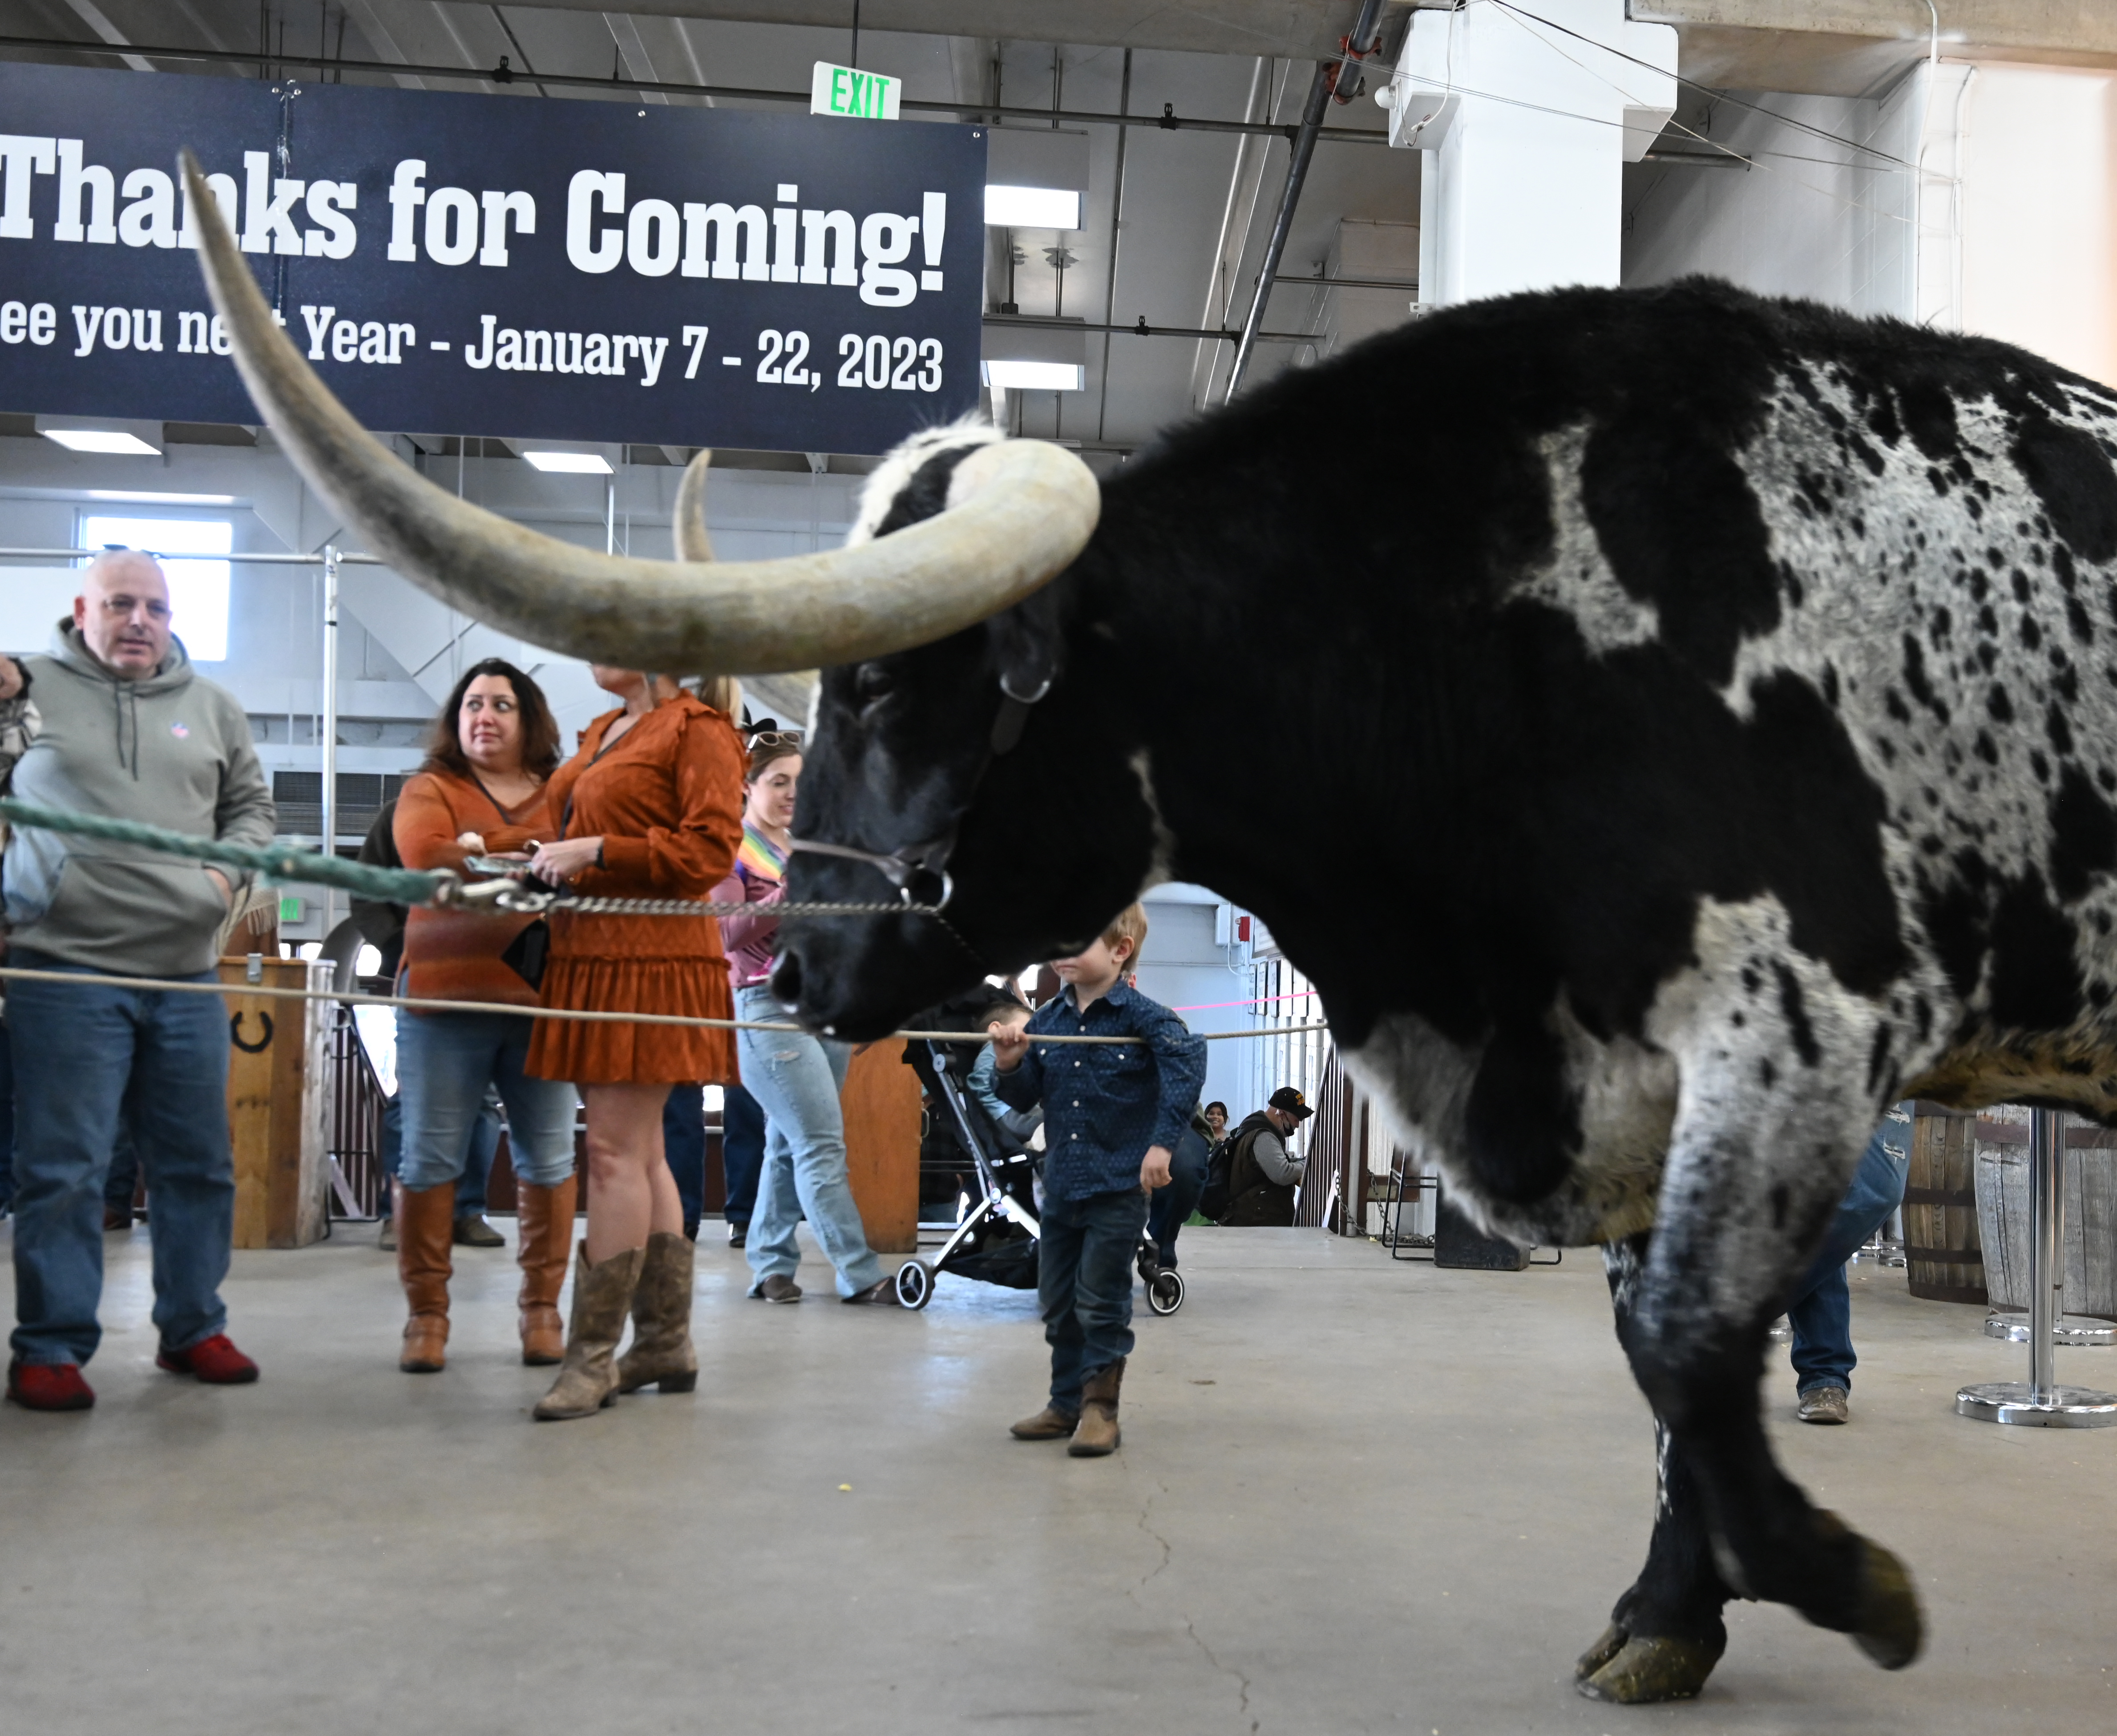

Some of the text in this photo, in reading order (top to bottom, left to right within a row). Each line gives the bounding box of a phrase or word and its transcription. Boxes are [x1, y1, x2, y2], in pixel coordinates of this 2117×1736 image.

[830, 68, 889, 119] EXIT
[0, 134, 946, 307] Thanks for Coming!
[72, 304, 163, 357] you
[177, 309, 286, 355] ne
[300, 305, 416, 364] Year
[431, 341, 450, 351] -
[465, 314, 669, 387] January
[683, 325, 709, 379] 7
[723, 356, 742, 366] -
[757, 329, 821, 392] 22,
[837, 334, 943, 392] 2023
